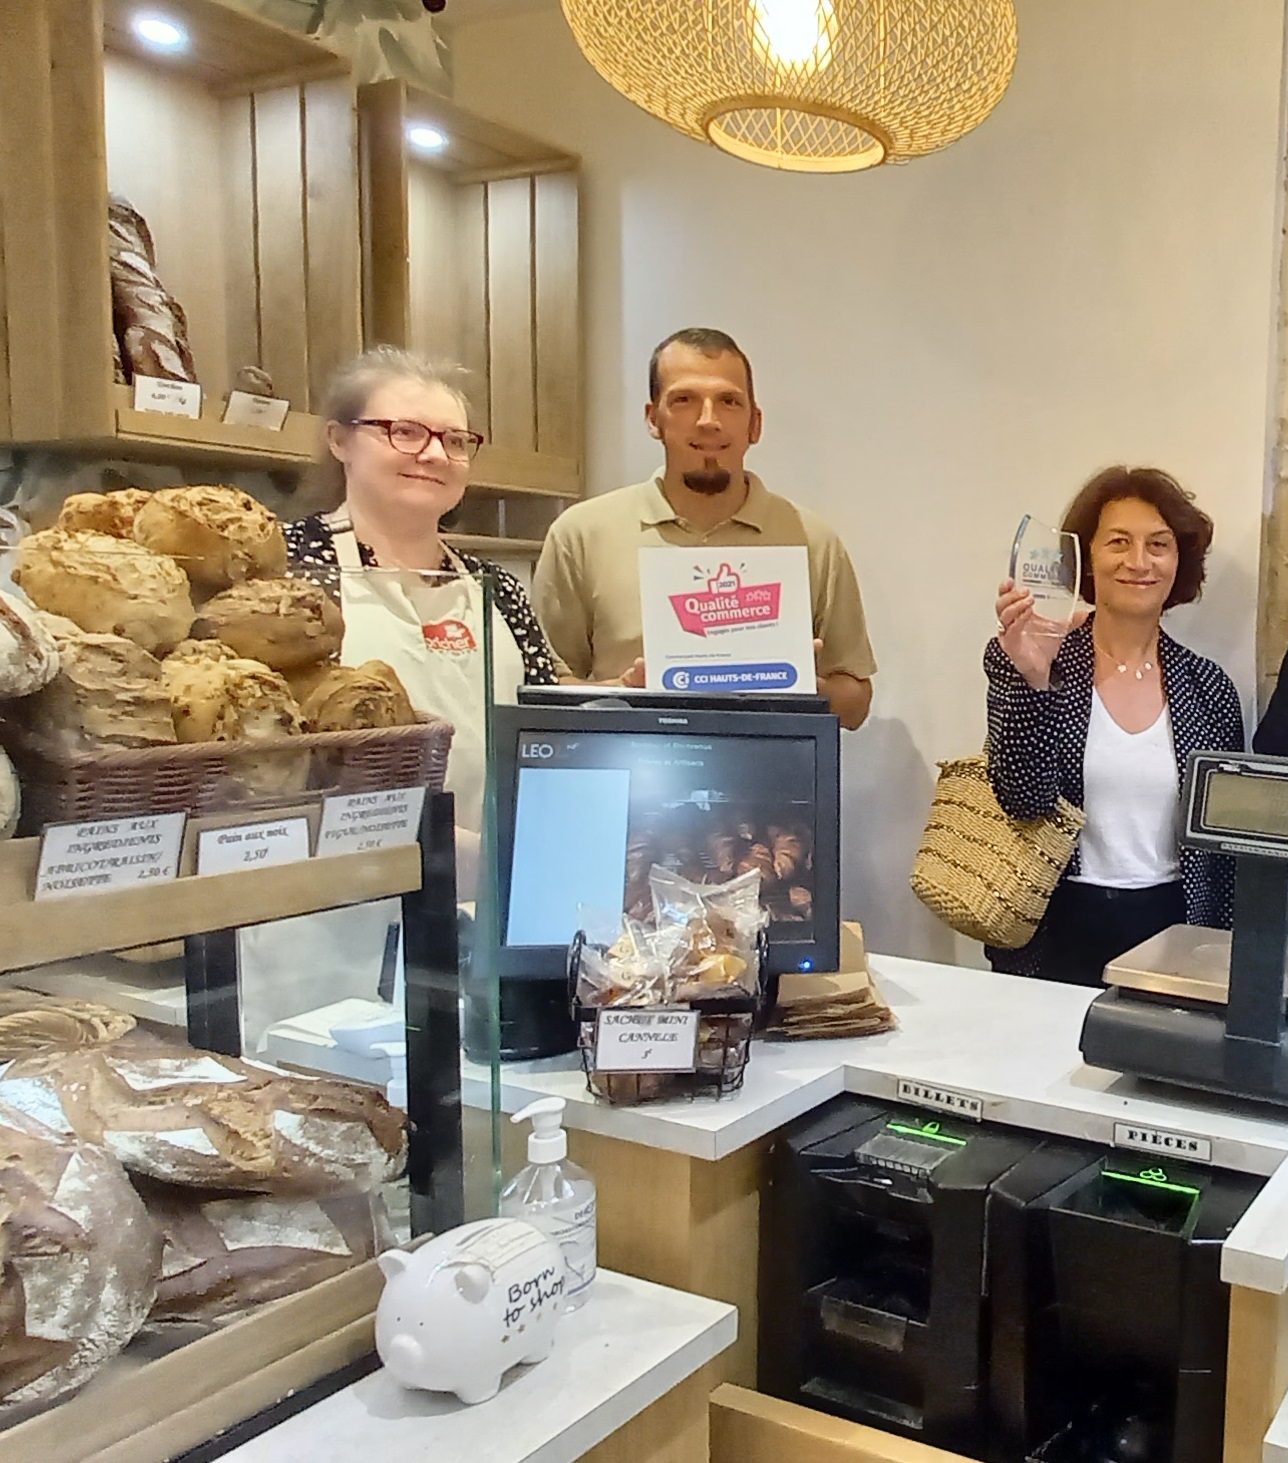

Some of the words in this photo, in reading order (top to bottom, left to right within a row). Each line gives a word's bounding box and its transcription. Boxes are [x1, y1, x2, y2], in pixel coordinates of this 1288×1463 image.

[719, 580, 736, 589] 2021
[684, 595, 740, 614] Qualité
[700, 604, 771, 622] commerce
[694, 674, 708, 684] CCI
[710, 671, 787, 683] HAUTS-DE-FRANCE
[604, 1014, 655, 1026] SACHET
[618, 1032, 678, 1043] CANNELE
[903, 1083, 979, 1112] BILLETS
[508, 1267, 555, 1303] Born
[503, 1304, 526, 1328] to
